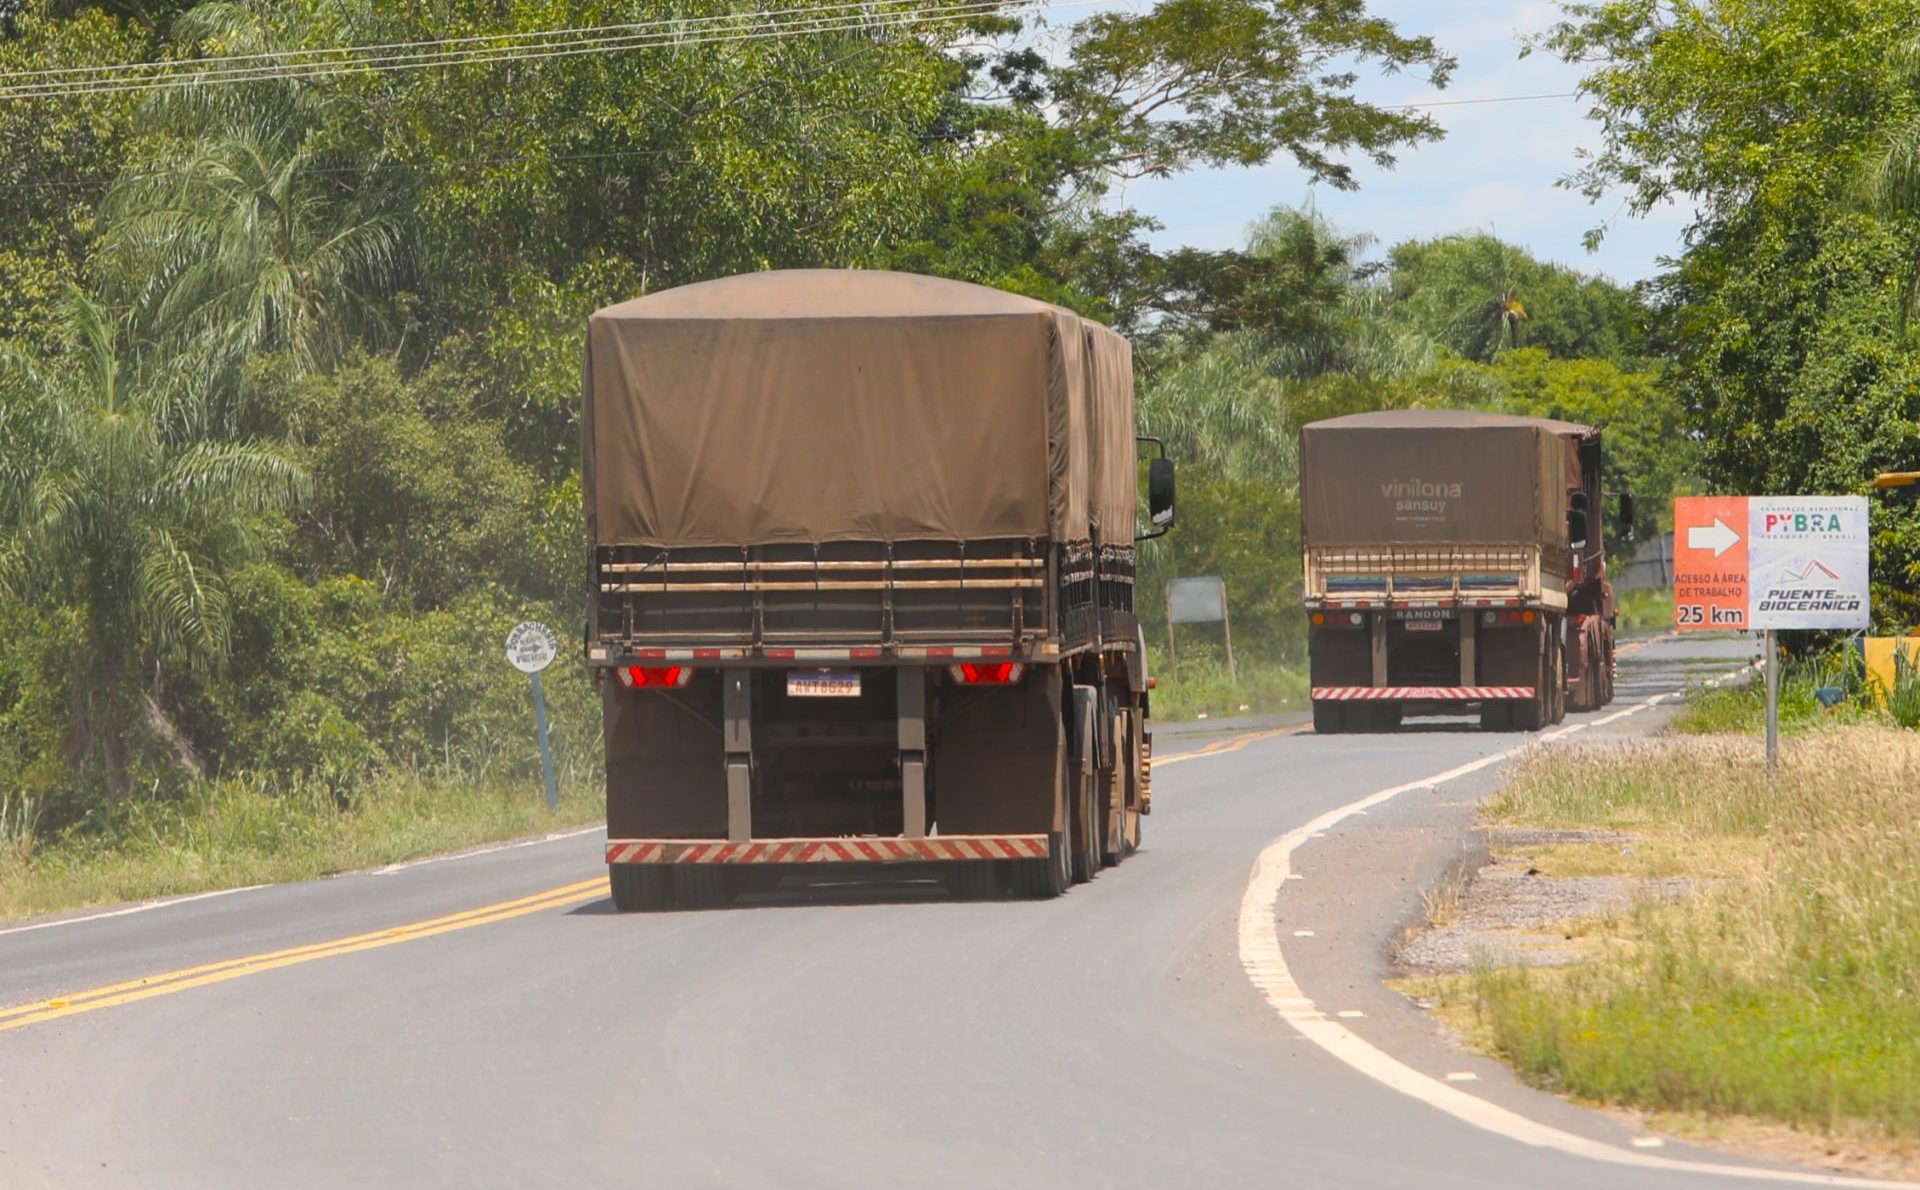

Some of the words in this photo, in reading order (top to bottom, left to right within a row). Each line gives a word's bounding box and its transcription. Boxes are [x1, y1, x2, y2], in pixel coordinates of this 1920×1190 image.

[1380, 478, 1462, 498] vinilona
[1395, 500, 1447, 513] sansuy
[1765, 514, 1842, 532] PYBRA
[1674, 574, 1711, 584] ACESSO
[1722, 571, 1746, 583] ÁREA
[1680, 587, 1692, 597] DE
[1694, 586, 1742, 597] TRABALHO
[1767, 589, 1837, 600] PUENTE
[1758, 600, 1861, 611] BIOCEANICA
[1396, 609, 1451, 619] RANDON
[1679, 606, 1703, 623] 25
[1711, 606, 1743, 623] km
